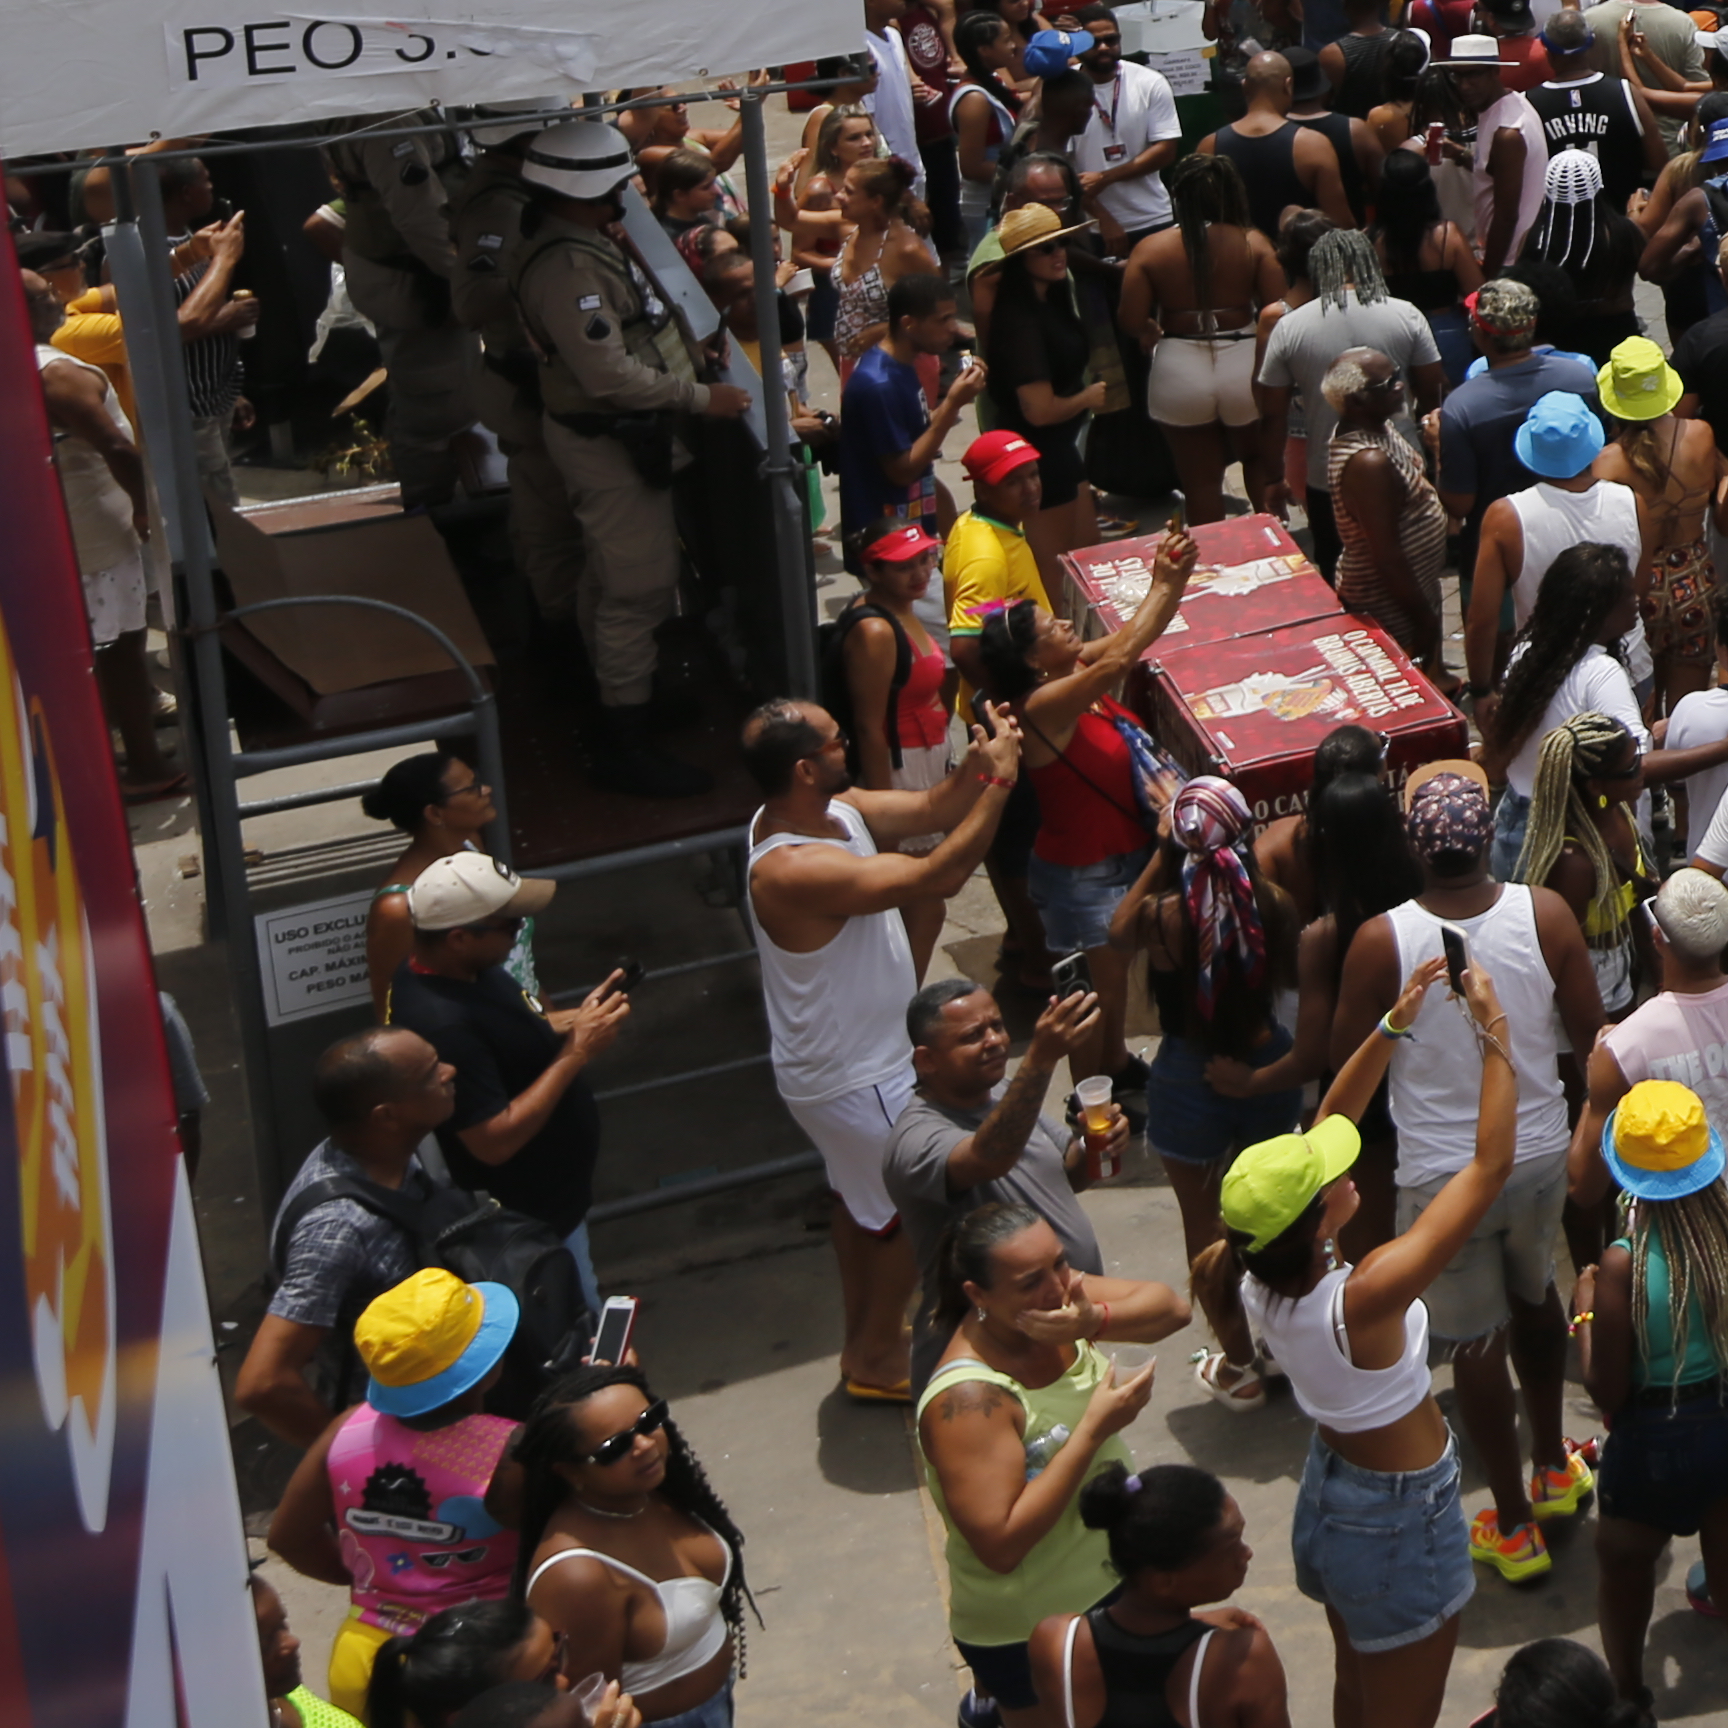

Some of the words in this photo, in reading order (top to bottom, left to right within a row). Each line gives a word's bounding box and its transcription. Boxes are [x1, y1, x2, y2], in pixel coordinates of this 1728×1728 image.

[183, 20, 365, 82] PEO
[1544, 113, 1609, 141] IRVING
[273, 926, 309, 944] USO
[306, 975, 346, 994] PESO
